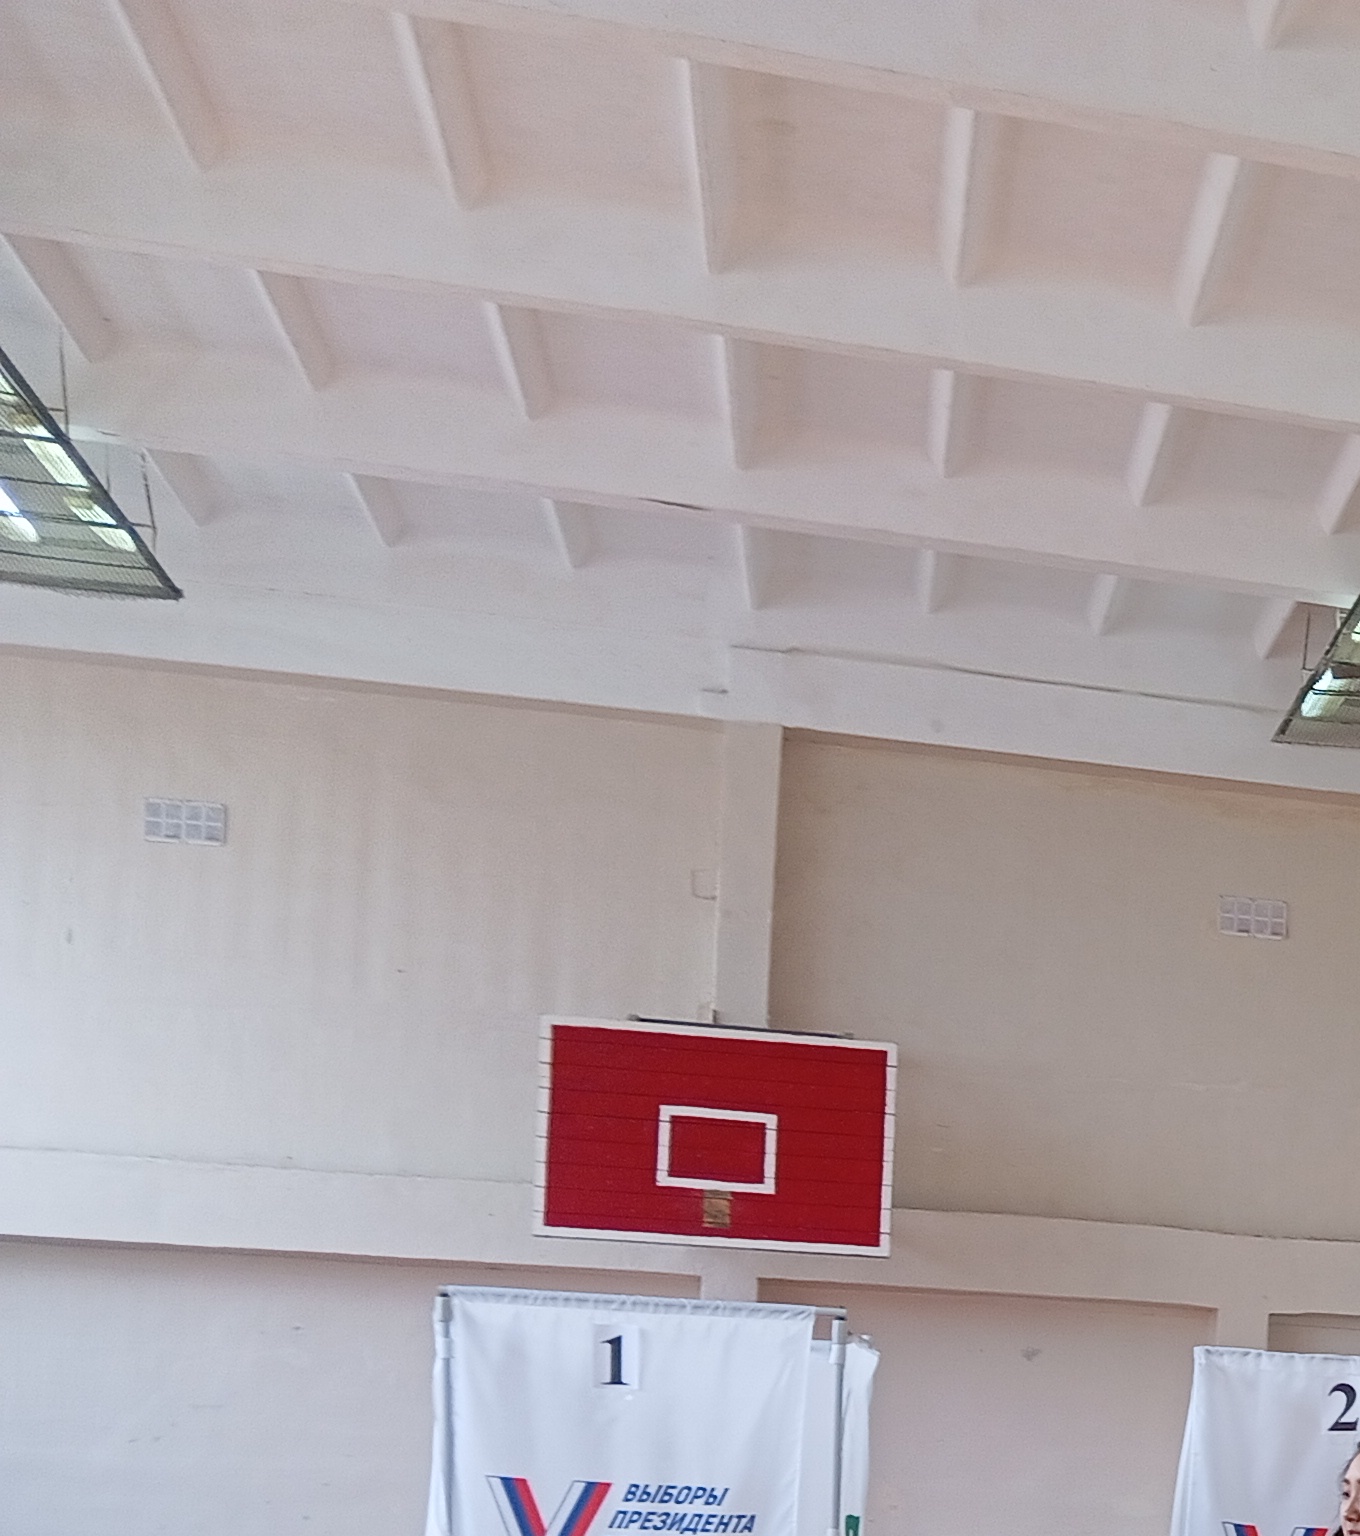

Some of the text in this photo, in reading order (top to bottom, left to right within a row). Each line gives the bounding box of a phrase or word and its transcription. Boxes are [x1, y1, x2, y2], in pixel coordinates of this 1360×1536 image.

[600, 1333, 630, 1386] 1
[1327, 1382, 1359, 1432] 2
[622, 1483, 730, 1507] ВЫБОРЫ
[608, 1510, 756, 1535] ПРЕЗИДЕНТА
